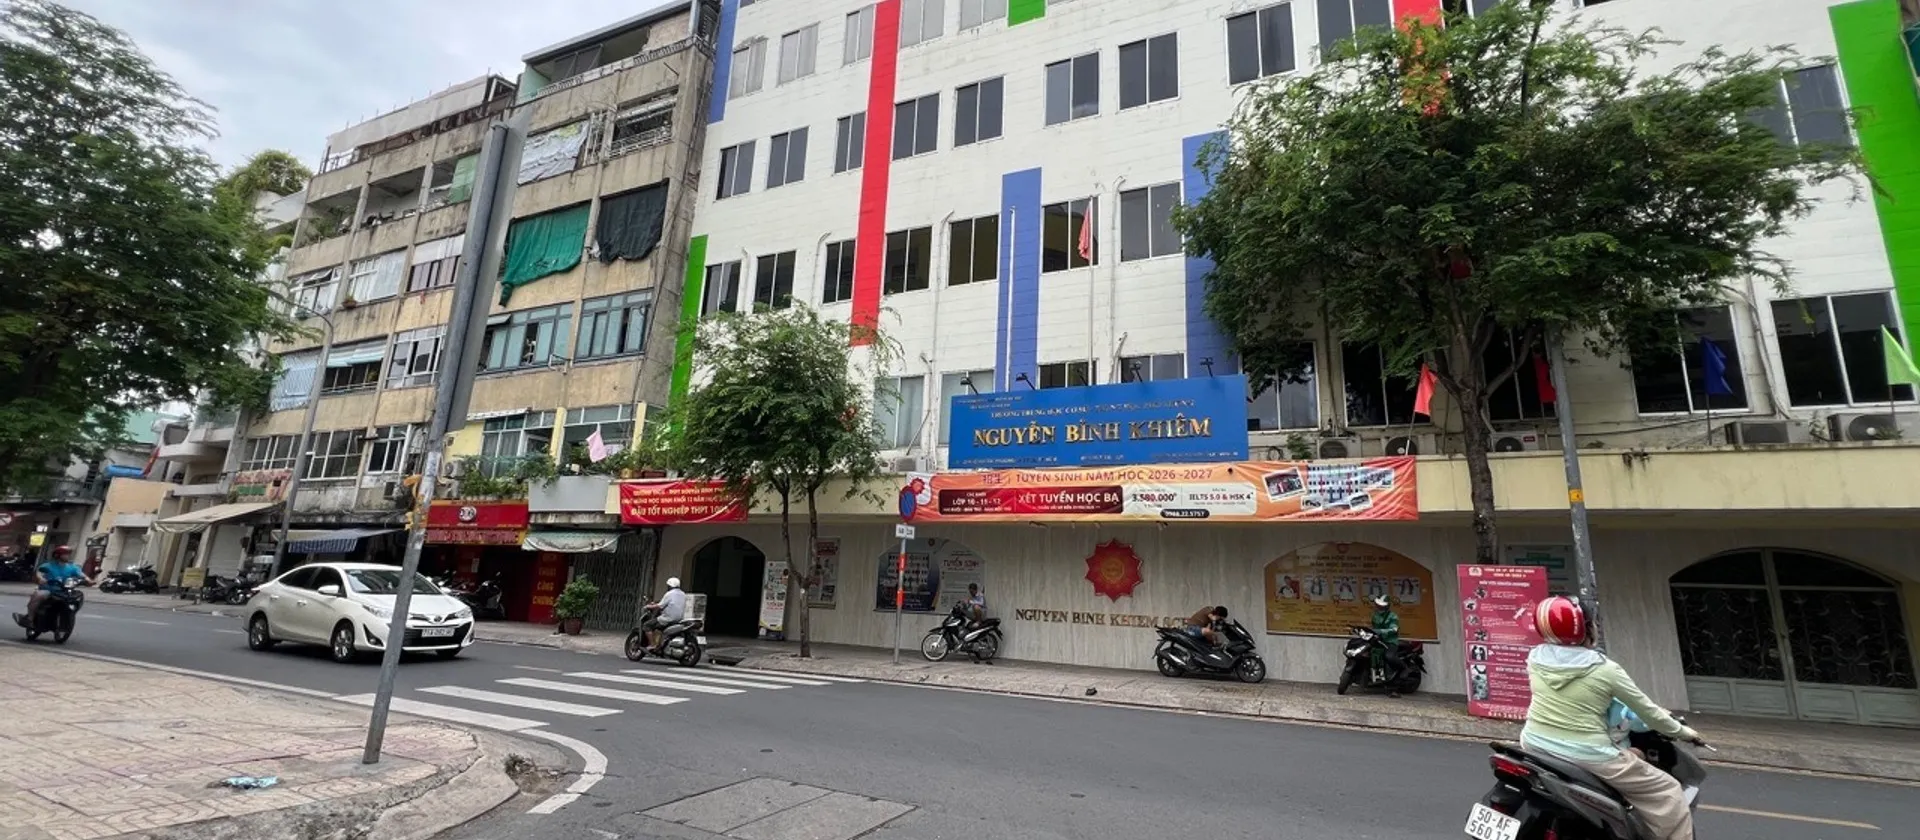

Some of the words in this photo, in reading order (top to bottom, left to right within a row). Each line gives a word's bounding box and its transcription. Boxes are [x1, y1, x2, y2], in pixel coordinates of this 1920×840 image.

[1054, 472, 1083, 482] SINH
[1148, 469, 1176, 481] 2026
[1077, 493, 1101, 506] HỌC
[1104, 492, 1120, 505] BẠ
[1189, 493, 1209, 501] IELTS
[1015, 609, 1068, 623] NGUYEN
[1072, 611, 1106, 625] BINH
